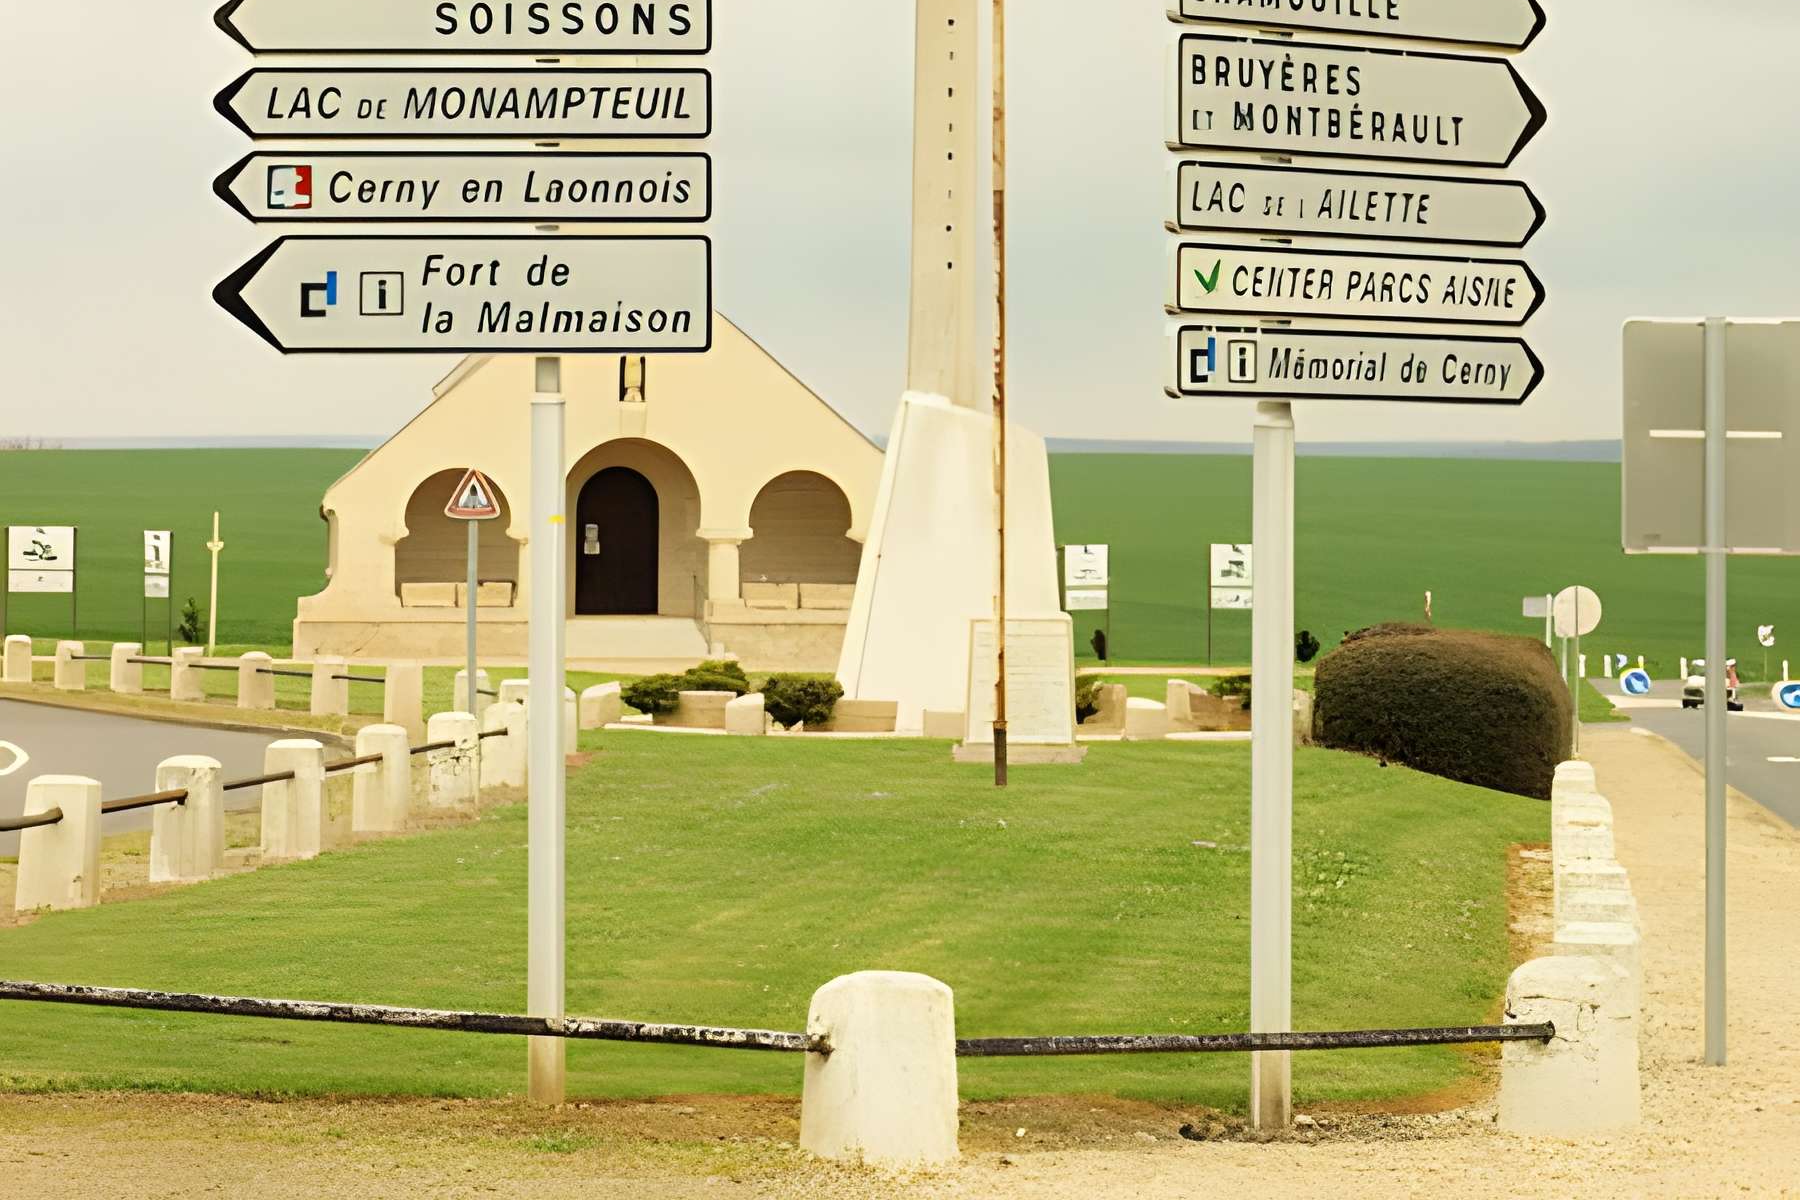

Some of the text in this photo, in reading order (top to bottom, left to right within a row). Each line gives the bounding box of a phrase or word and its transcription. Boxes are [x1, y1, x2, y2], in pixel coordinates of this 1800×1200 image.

[436, 2, 691, 35] SOISSONS
[1192, 53, 1361, 96] BRUYÈRES
[267, 87, 690, 119] LAC DE MONAMPTEUIL
[1233, 101, 1464, 146] MONTBÉRAULT
[330, 170, 690, 210] Cerny en Laonnois
[1192, 181, 1244, 213] LAC
[422, 254, 569, 286] Fort de
[1233, 265, 1516, 308] CENTER PARCS AISNE
[422, 301, 690, 333] la Malmaison
[1269, 347, 1511, 391] Mémorial de Cerny
